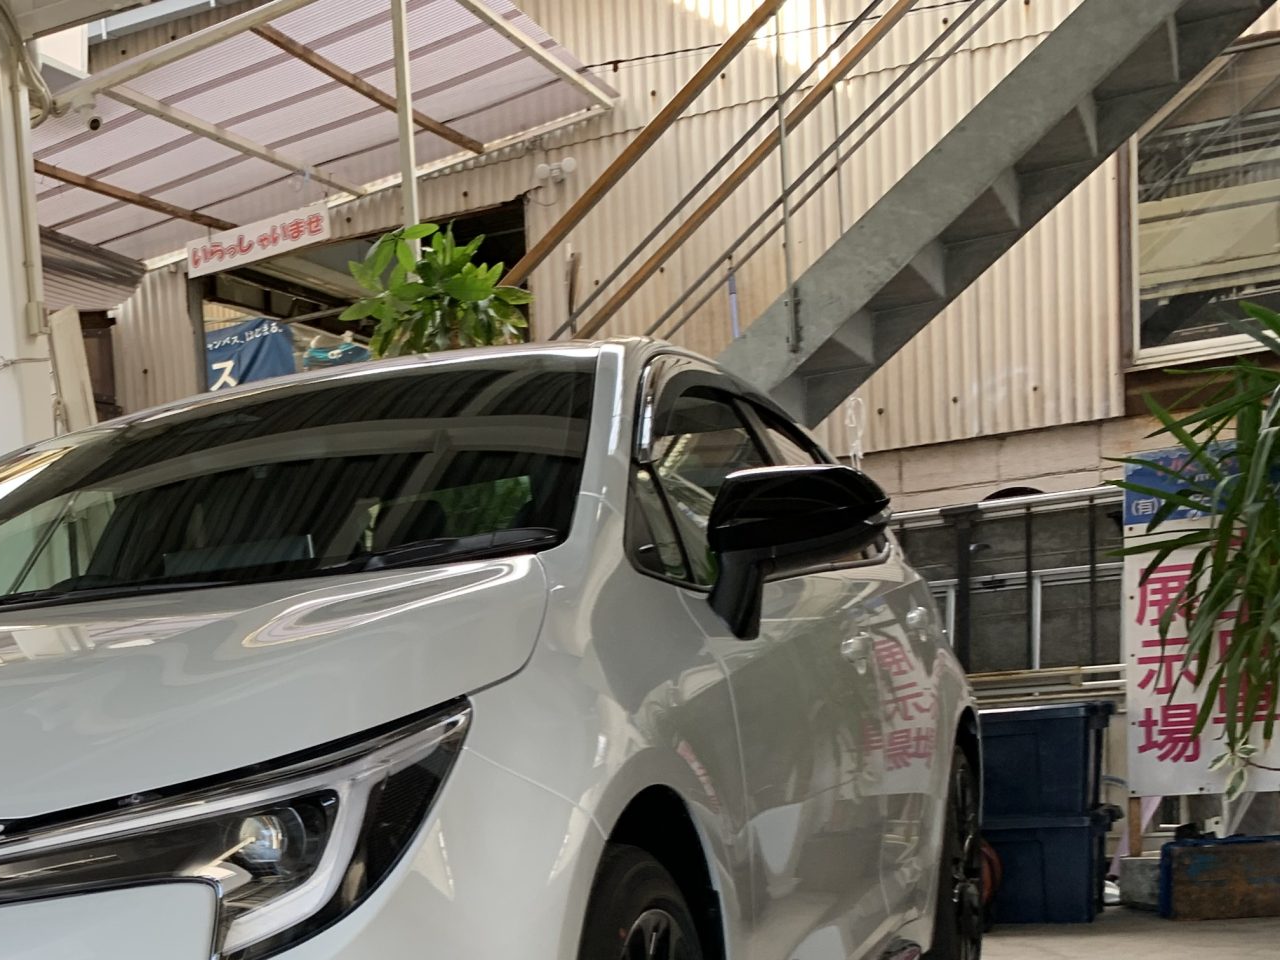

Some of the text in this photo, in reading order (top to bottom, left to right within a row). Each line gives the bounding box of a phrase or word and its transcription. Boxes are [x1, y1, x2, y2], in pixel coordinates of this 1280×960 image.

[192, 213, 323, 268] いらっしゃいませ
[210, 360, 237, 391] ス
[1135, 562, 1201, 763] 展示場
